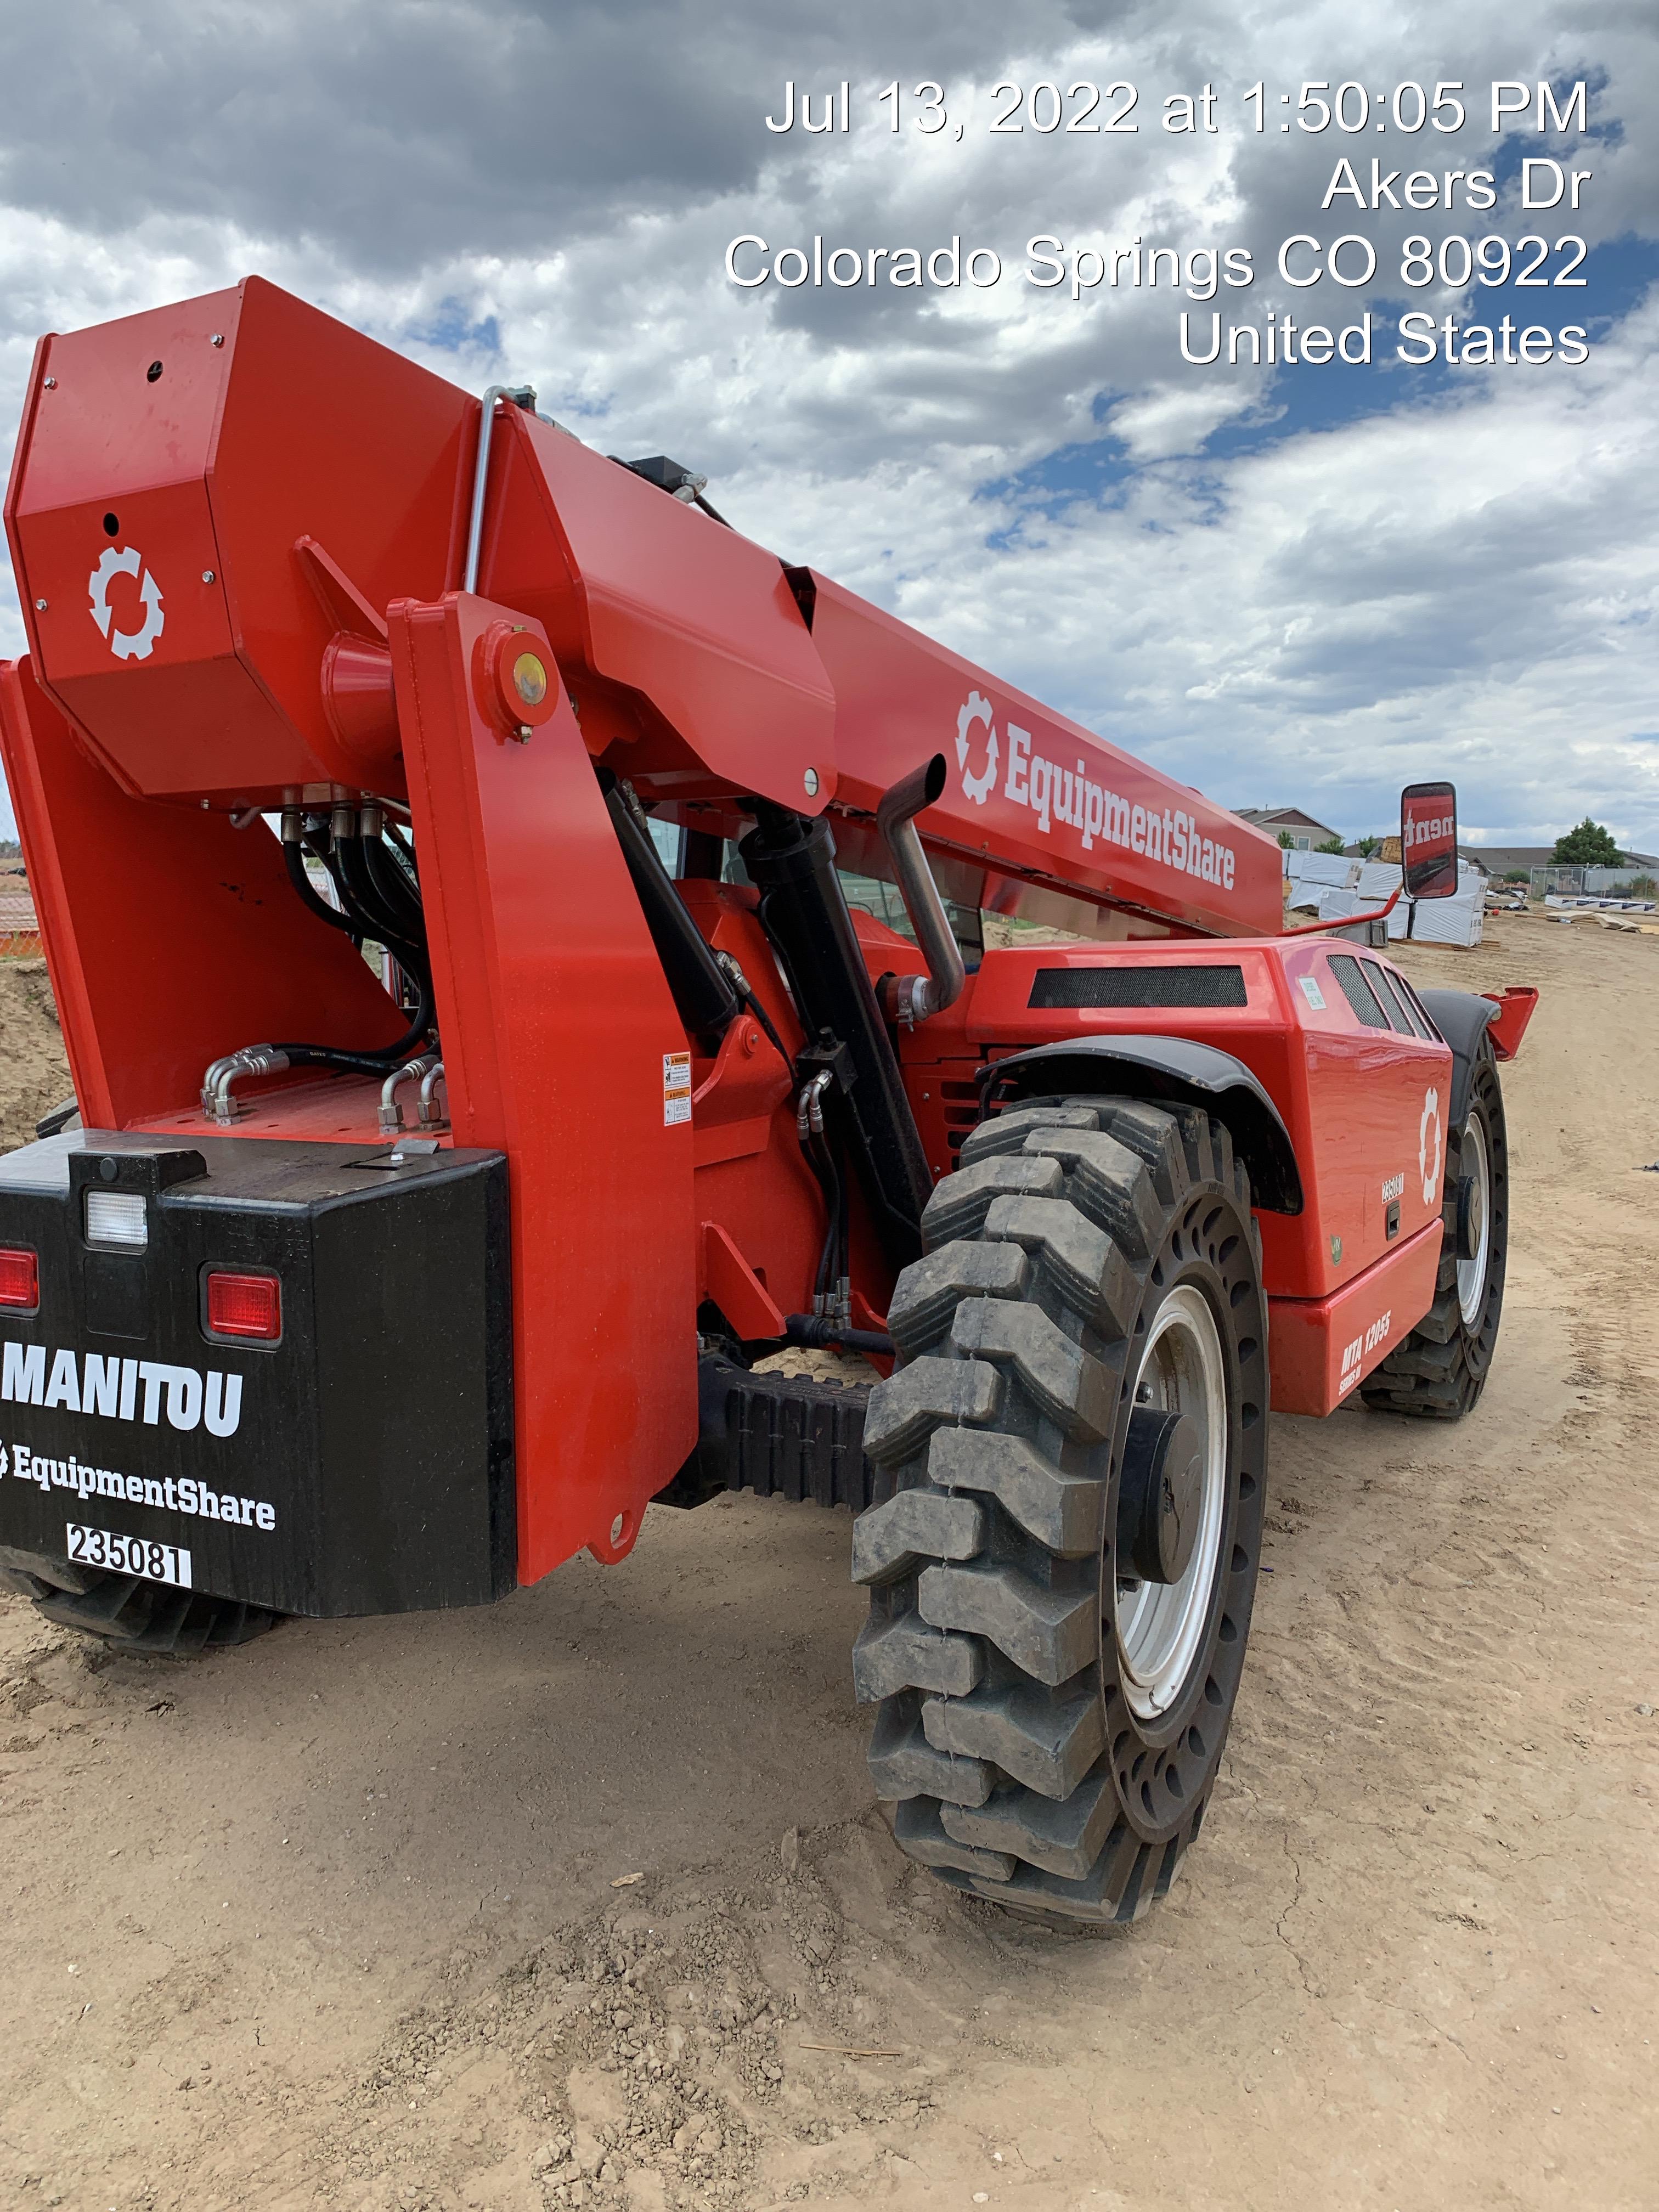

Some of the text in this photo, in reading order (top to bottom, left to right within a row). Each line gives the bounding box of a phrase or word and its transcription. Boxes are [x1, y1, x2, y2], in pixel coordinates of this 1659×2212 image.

[1005, 722, 1235, 890] EquipmentShare
[1383, 1174, 1403, 1202] 235081
[1341, 1310, 1391, 1376] MTA 12055
[1, 1341, 243, 1437] MANITOU
[12, 1444, 275, 1531] EquipmentShare
[70, 1525, 181, 1585] 235081
